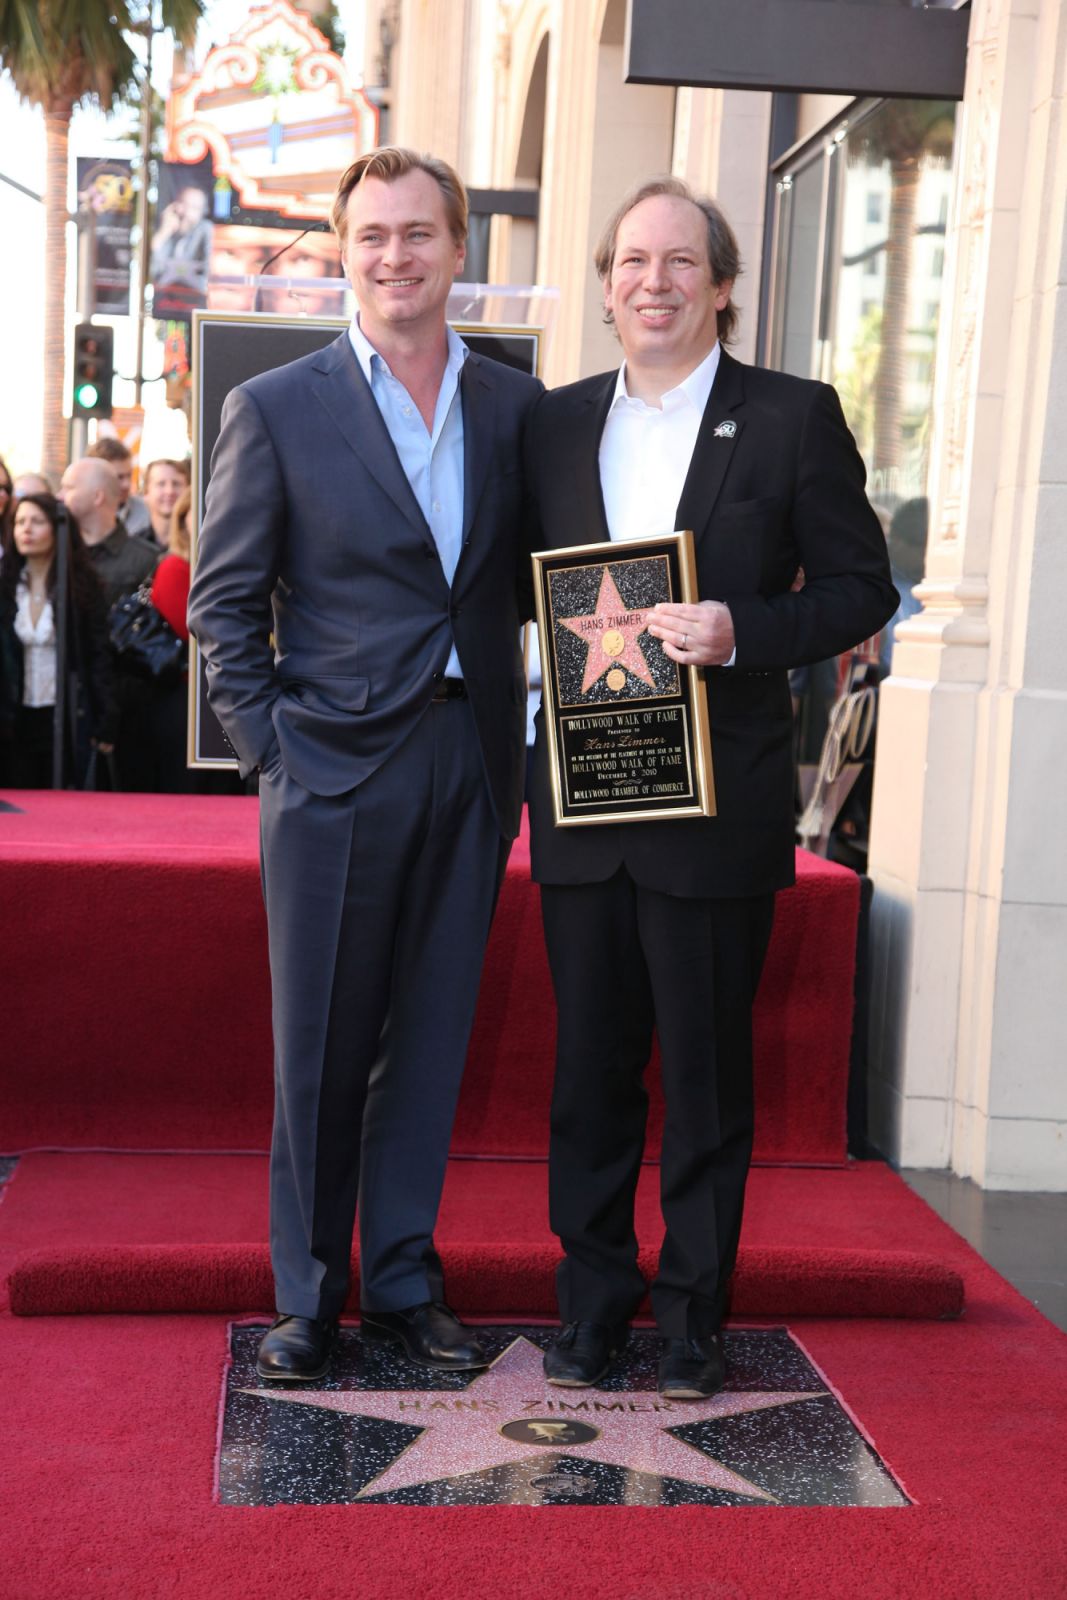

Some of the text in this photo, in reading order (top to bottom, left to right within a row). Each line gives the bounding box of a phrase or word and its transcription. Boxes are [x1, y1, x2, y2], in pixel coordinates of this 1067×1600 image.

[580, 613, 642, 631] HANS ZIMMER
[568, 710, 678, 731] HOLLYWOOD WALK OF FAME
[616, 735, 667, 748] Zimmer
[572, 754, 683, 773] HOLLYWOOD WALK OF FAME
[574, 782, 685, 800] HOLLYWOOD CHAMBER OF COMMERCE
[399, 1399, 677, 1413] HANS ZIMMER
